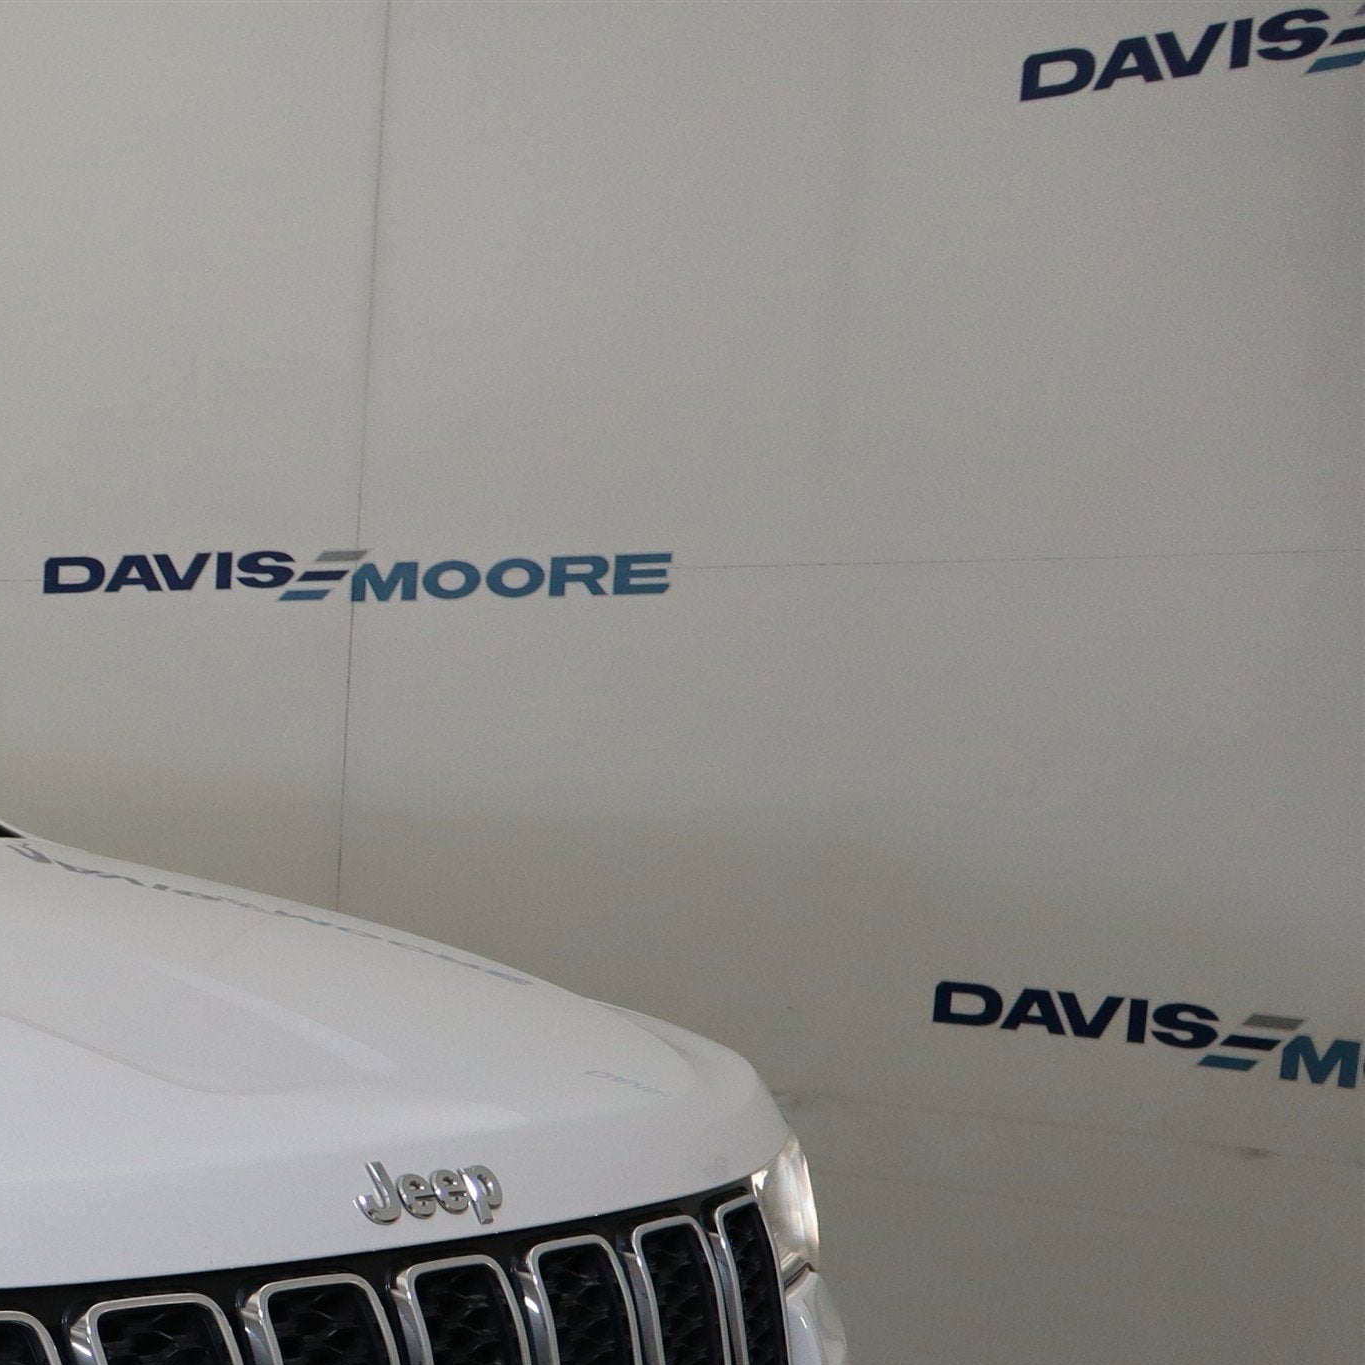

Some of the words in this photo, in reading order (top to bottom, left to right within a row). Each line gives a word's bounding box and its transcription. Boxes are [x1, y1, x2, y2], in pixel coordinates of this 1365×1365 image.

[1019, 7, 1331, 102] DAVIS
[42, 549, 296, 595] DAVIS
[349, 552, 673, 603] MOORE
[932, 980, 1220, 1050] DAVIS
[1279, 1034, 1365, 1090] M
[352, 1160, 504, 1226] Jeep
